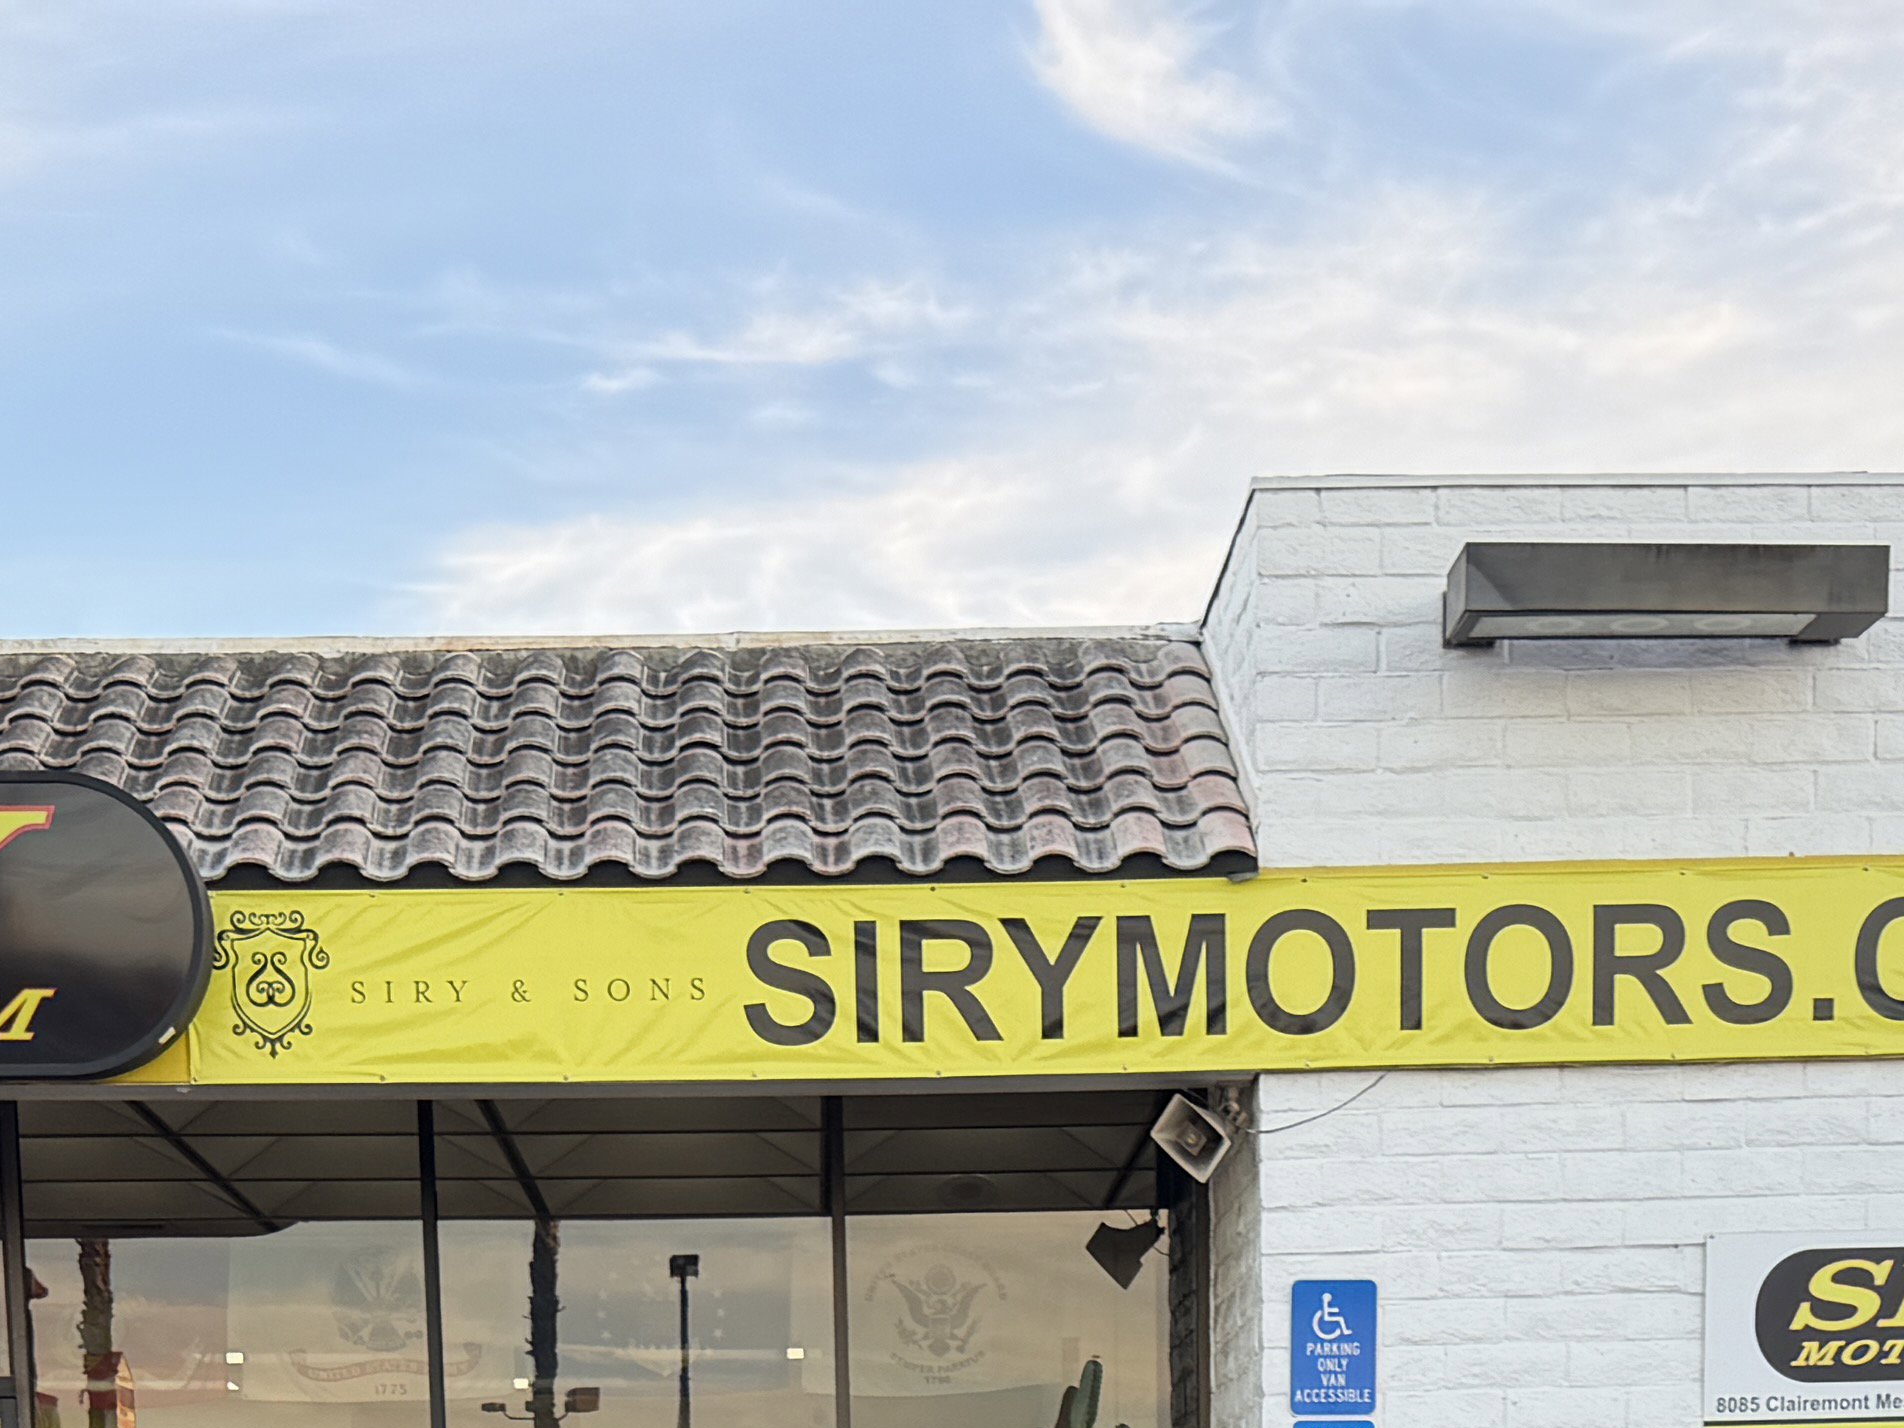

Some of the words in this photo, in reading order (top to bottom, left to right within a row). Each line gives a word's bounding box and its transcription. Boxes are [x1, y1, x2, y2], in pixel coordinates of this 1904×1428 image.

[351, 979, 470, 1004] SIRY
[511, 979, 532, 1003] &
[574, 977, 706, 1002] SONS
[1306, 1342, 1361, 1356] PARKING
[1317, 1358, 1349, 1372] ONLY
[1320, 1373, 1346, 1387] VAN
[373, 1382, 409, 1396] 1775
[1294, 1388, 1372, 1404] ACCESSIBLE
[1716, 1396, 1761, 1413] 8085
[1765, 1393, 1870, 1412] Clairemont
